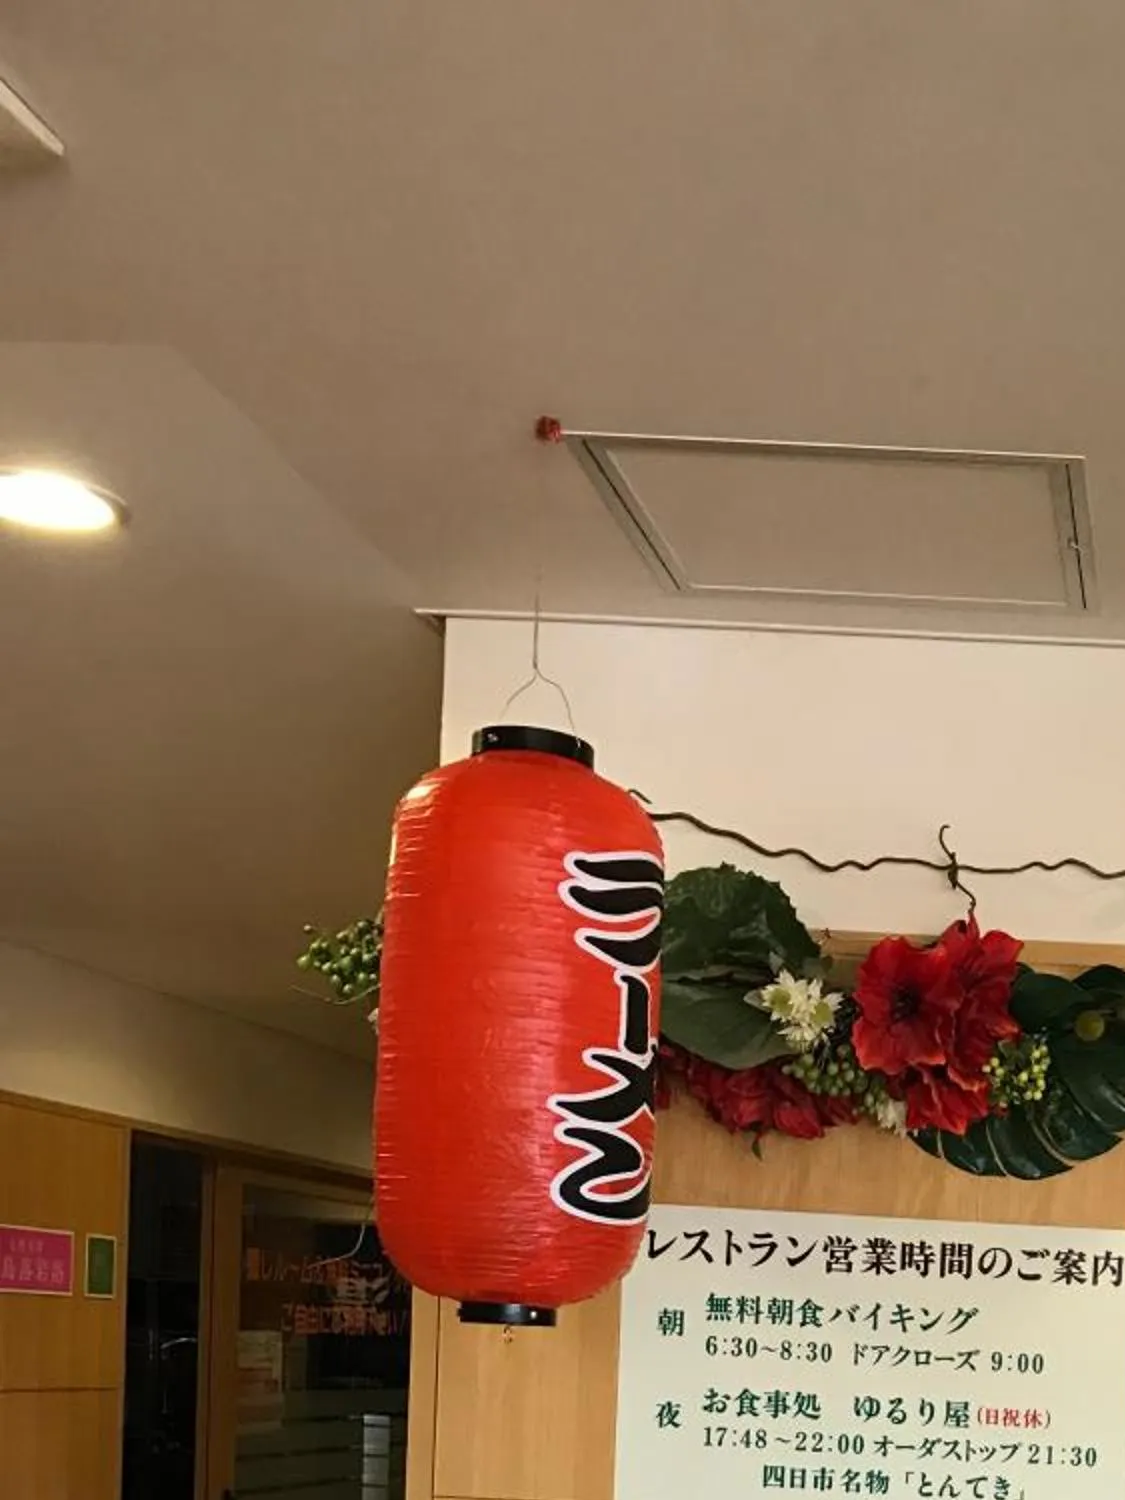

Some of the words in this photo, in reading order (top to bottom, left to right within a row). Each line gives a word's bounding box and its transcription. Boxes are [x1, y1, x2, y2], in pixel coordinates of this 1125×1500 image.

[646, 1228, 1125, 1288] レストラン営業時間のご案内
[656, 1306, 686, 1337] 朝
[705, 1291, 980, 1335] 無料朝食バイキング
[852, 1342, 981, 1372] ドアクローズ
[990, 1350, 1045, 1375] 9:00
[656, 1400, 682, 1429] 夜
[701, 1387, 822, 1421] お食事処
[853, 1394, 971, 1430] ゆるり屋
[873, 1434, 1023, 1463] オーダストップ
[1027, 1443, 1098, 1468] 21:30
